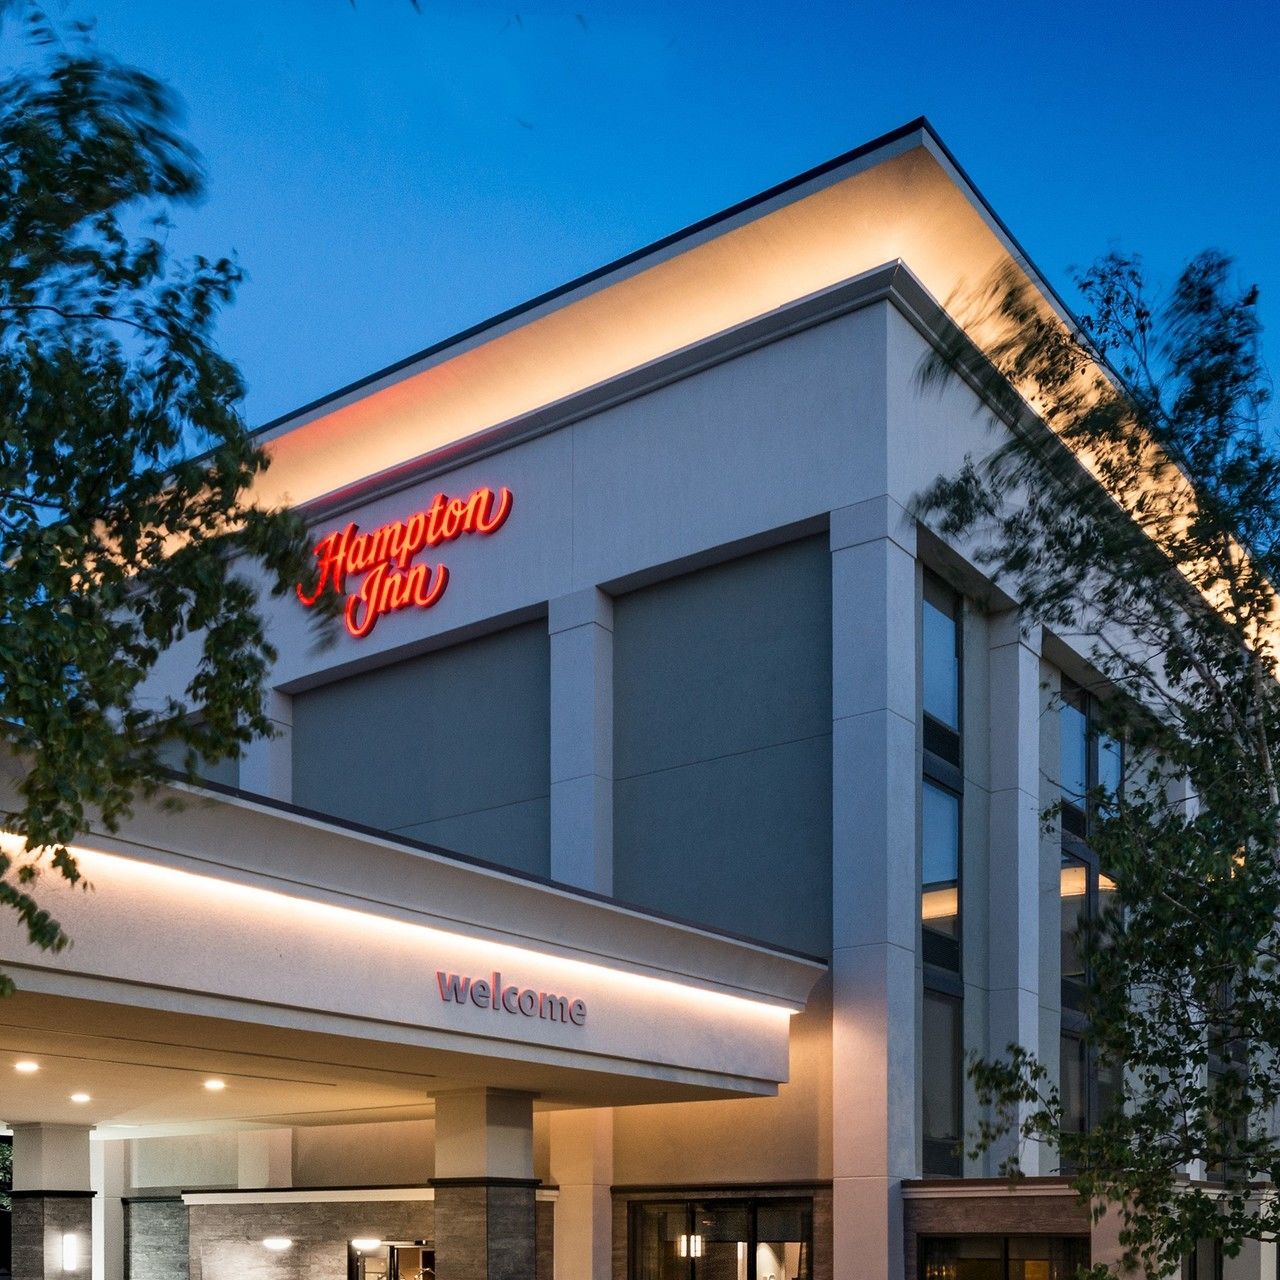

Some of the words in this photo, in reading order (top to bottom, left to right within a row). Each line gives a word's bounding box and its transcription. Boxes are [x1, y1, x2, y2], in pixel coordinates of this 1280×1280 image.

[297, 487, 513, 606] Hampton
[345, 562, 450, 638] Inn
[436, 971, 587, 1026] welcome
